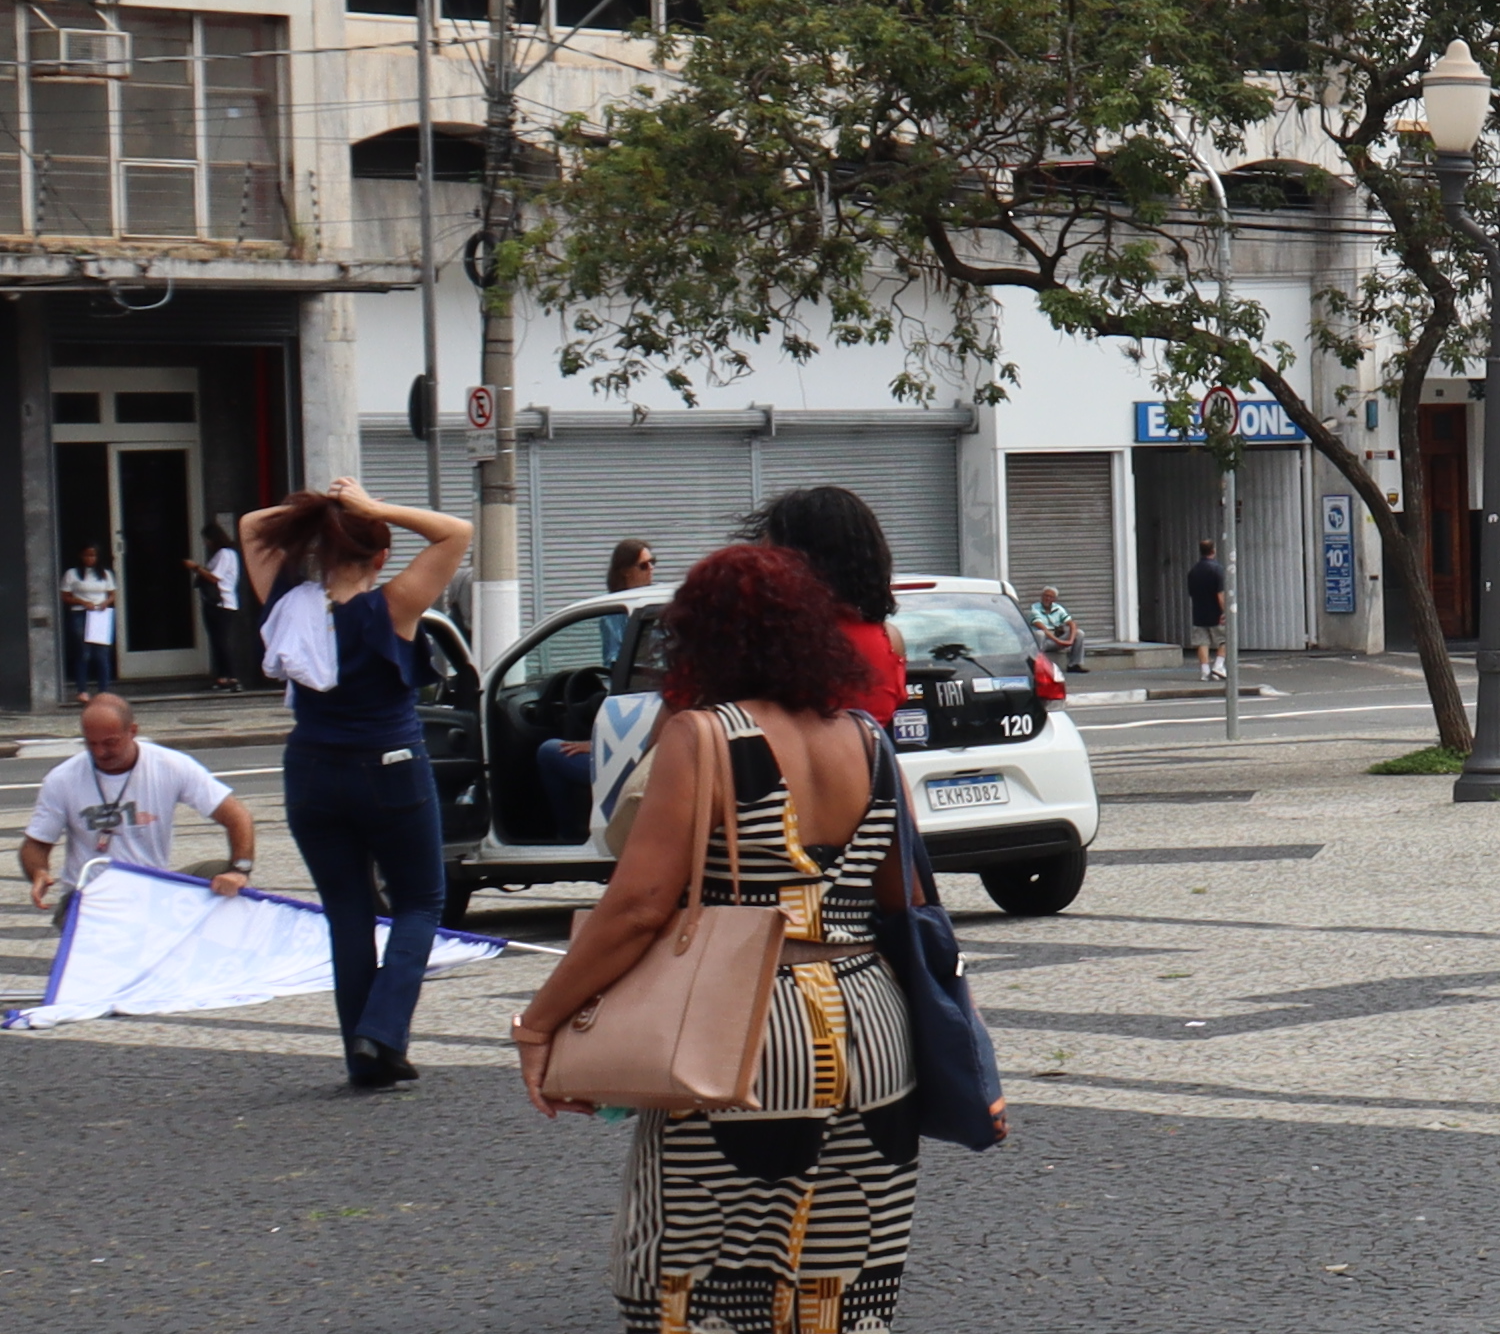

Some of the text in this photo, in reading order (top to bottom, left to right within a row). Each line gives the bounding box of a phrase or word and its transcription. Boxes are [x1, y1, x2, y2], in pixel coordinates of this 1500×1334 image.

[1326, 549, 1343, 567] 10
[935, 679, 965, 708] FIAT
[898, 724, 925, 738] 118
[1000, 714, 1034, 737] 120
[936, 784, 1002, 807] EKH3D82
